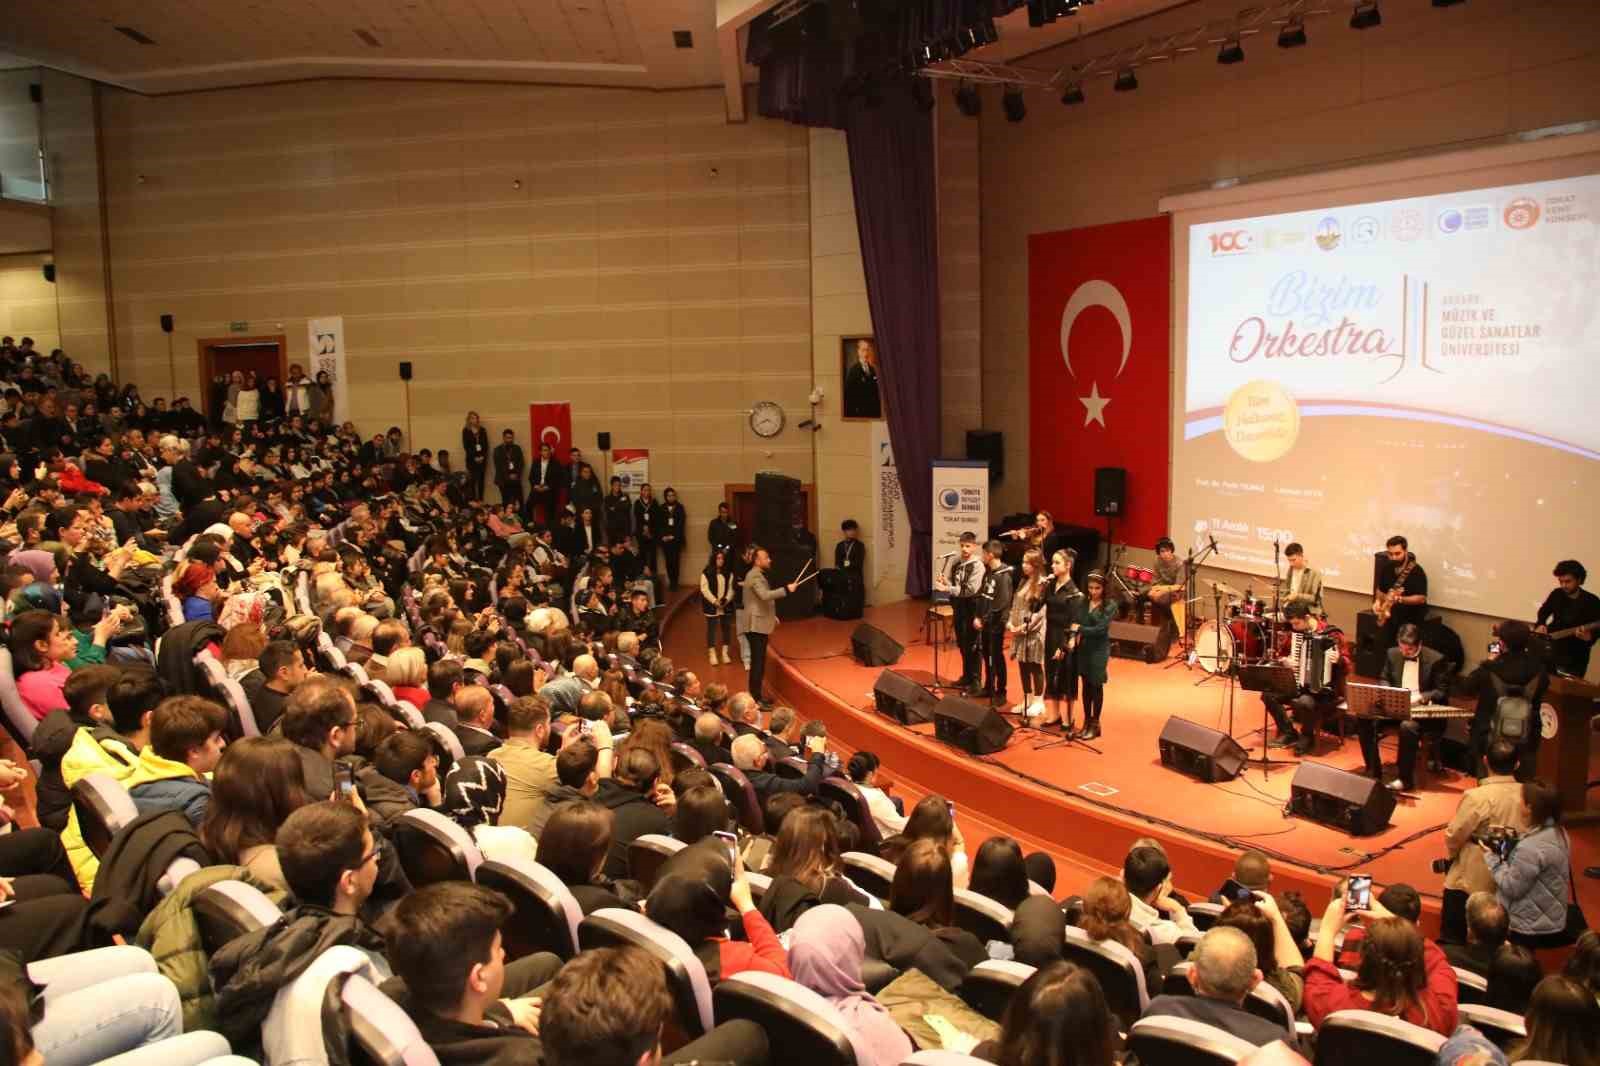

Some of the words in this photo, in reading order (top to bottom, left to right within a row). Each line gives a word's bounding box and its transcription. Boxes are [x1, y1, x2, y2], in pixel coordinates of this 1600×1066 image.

[1267, 270, 1380, 327] Bizim
[1481, 307, 1496, 321] VE
[1229, 316, 1395, 364] Orkestra
[1441, 325, 1475, 339] GÜZEL
[1479, 324, 1542, 338] SANATLAR
